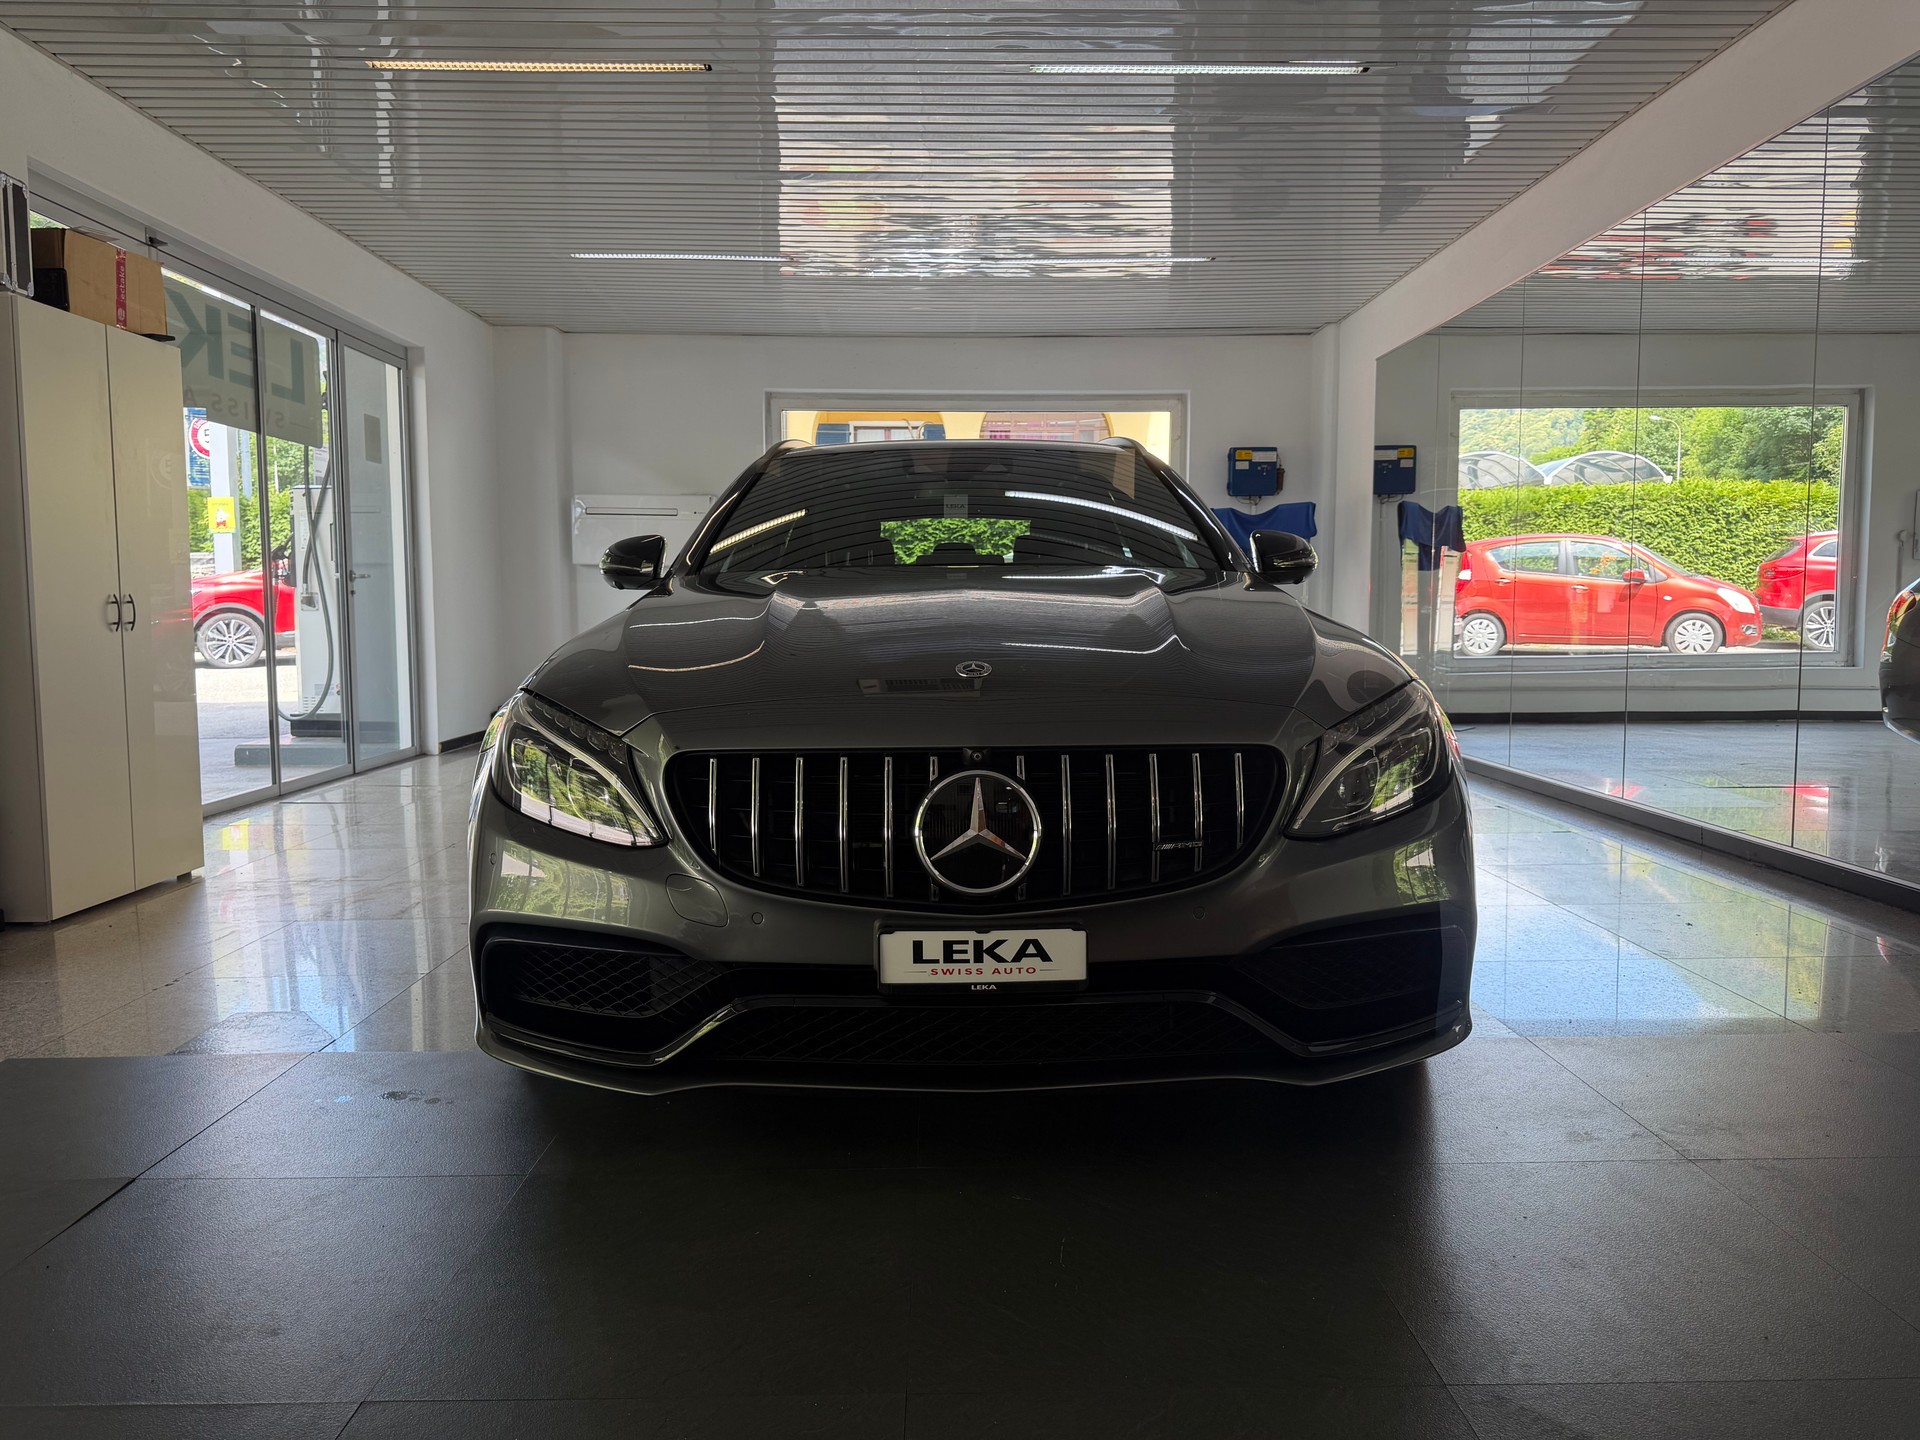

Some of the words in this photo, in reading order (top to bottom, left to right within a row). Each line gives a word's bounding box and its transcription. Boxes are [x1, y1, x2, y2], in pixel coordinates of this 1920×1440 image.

[912, 938, 1054, 964] LEKA
[930, 967, 984, 976] SWISS
[991, 966, 1037, 975] AUTO
